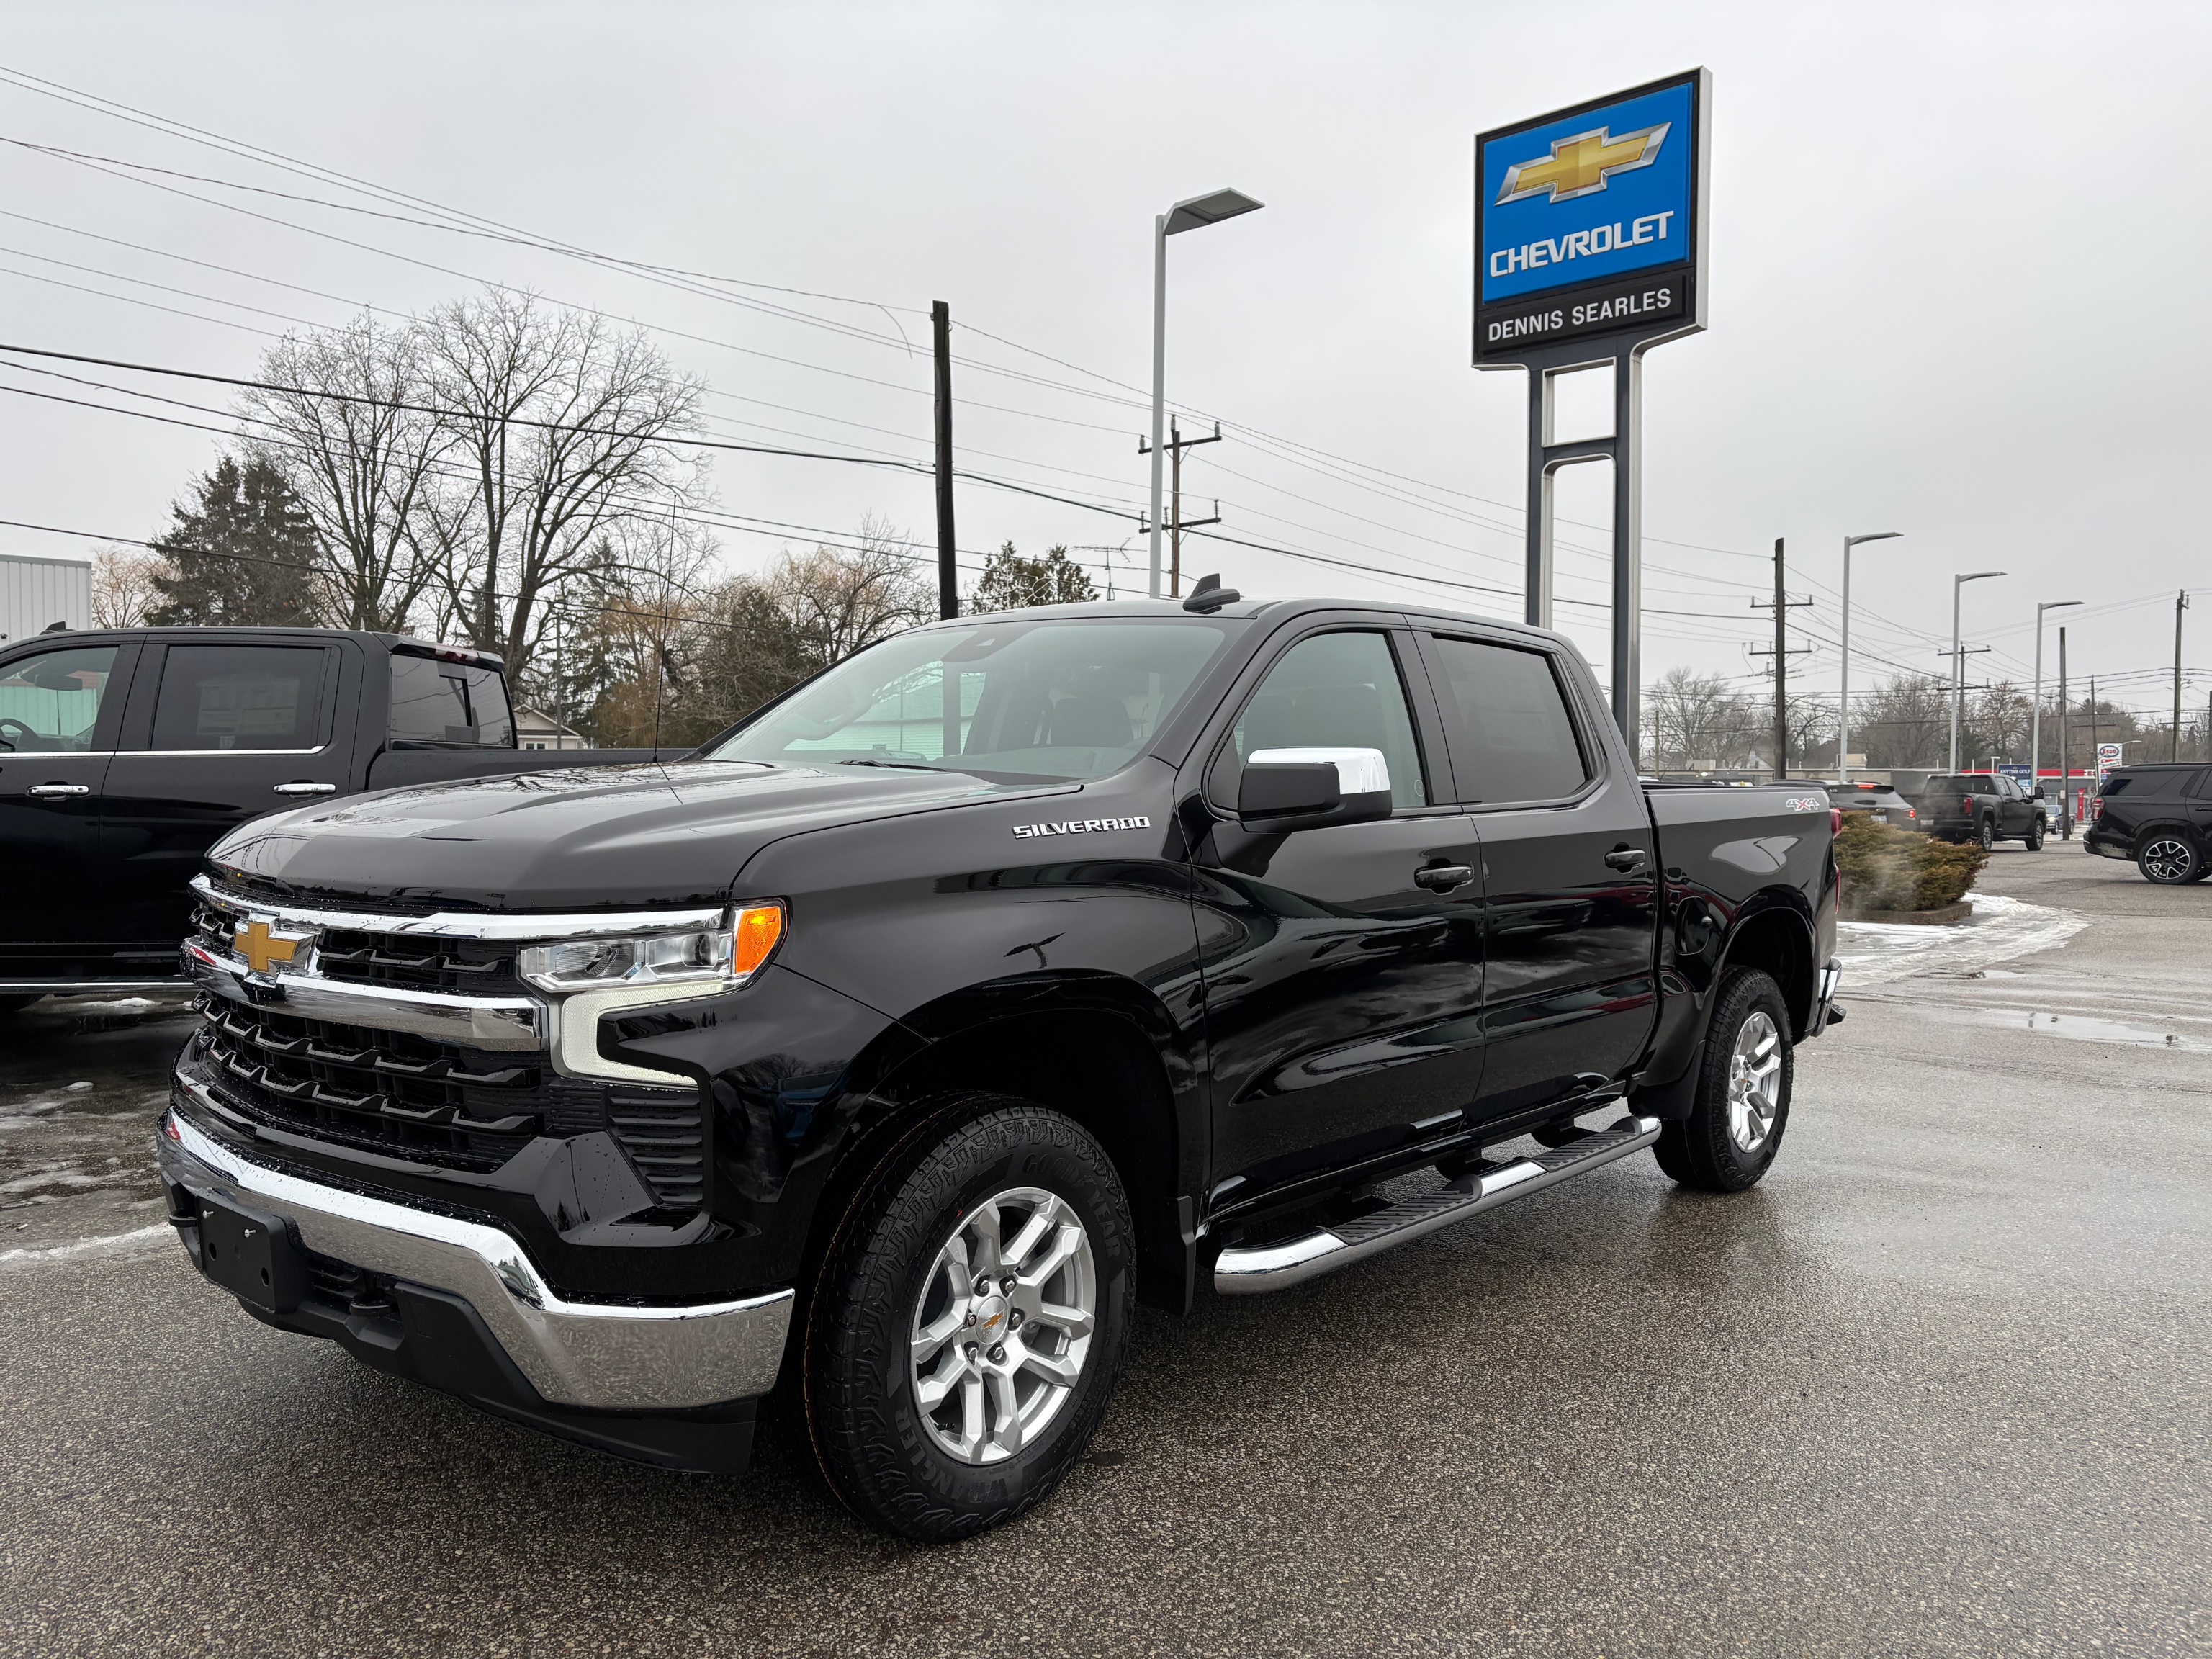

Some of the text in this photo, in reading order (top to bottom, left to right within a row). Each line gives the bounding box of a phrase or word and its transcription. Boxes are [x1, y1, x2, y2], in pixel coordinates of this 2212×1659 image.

[1491, 211, 1674, 276] CHEVROLET
[1488, 288, 1671, 341] DENNIS SEARLES
[1012, 816, 1151, 839] SILVERADO
[1022, 1153, 1121, 1258] GOODYEAR
[895, 1406, 1009, 1503] WRANGLER
